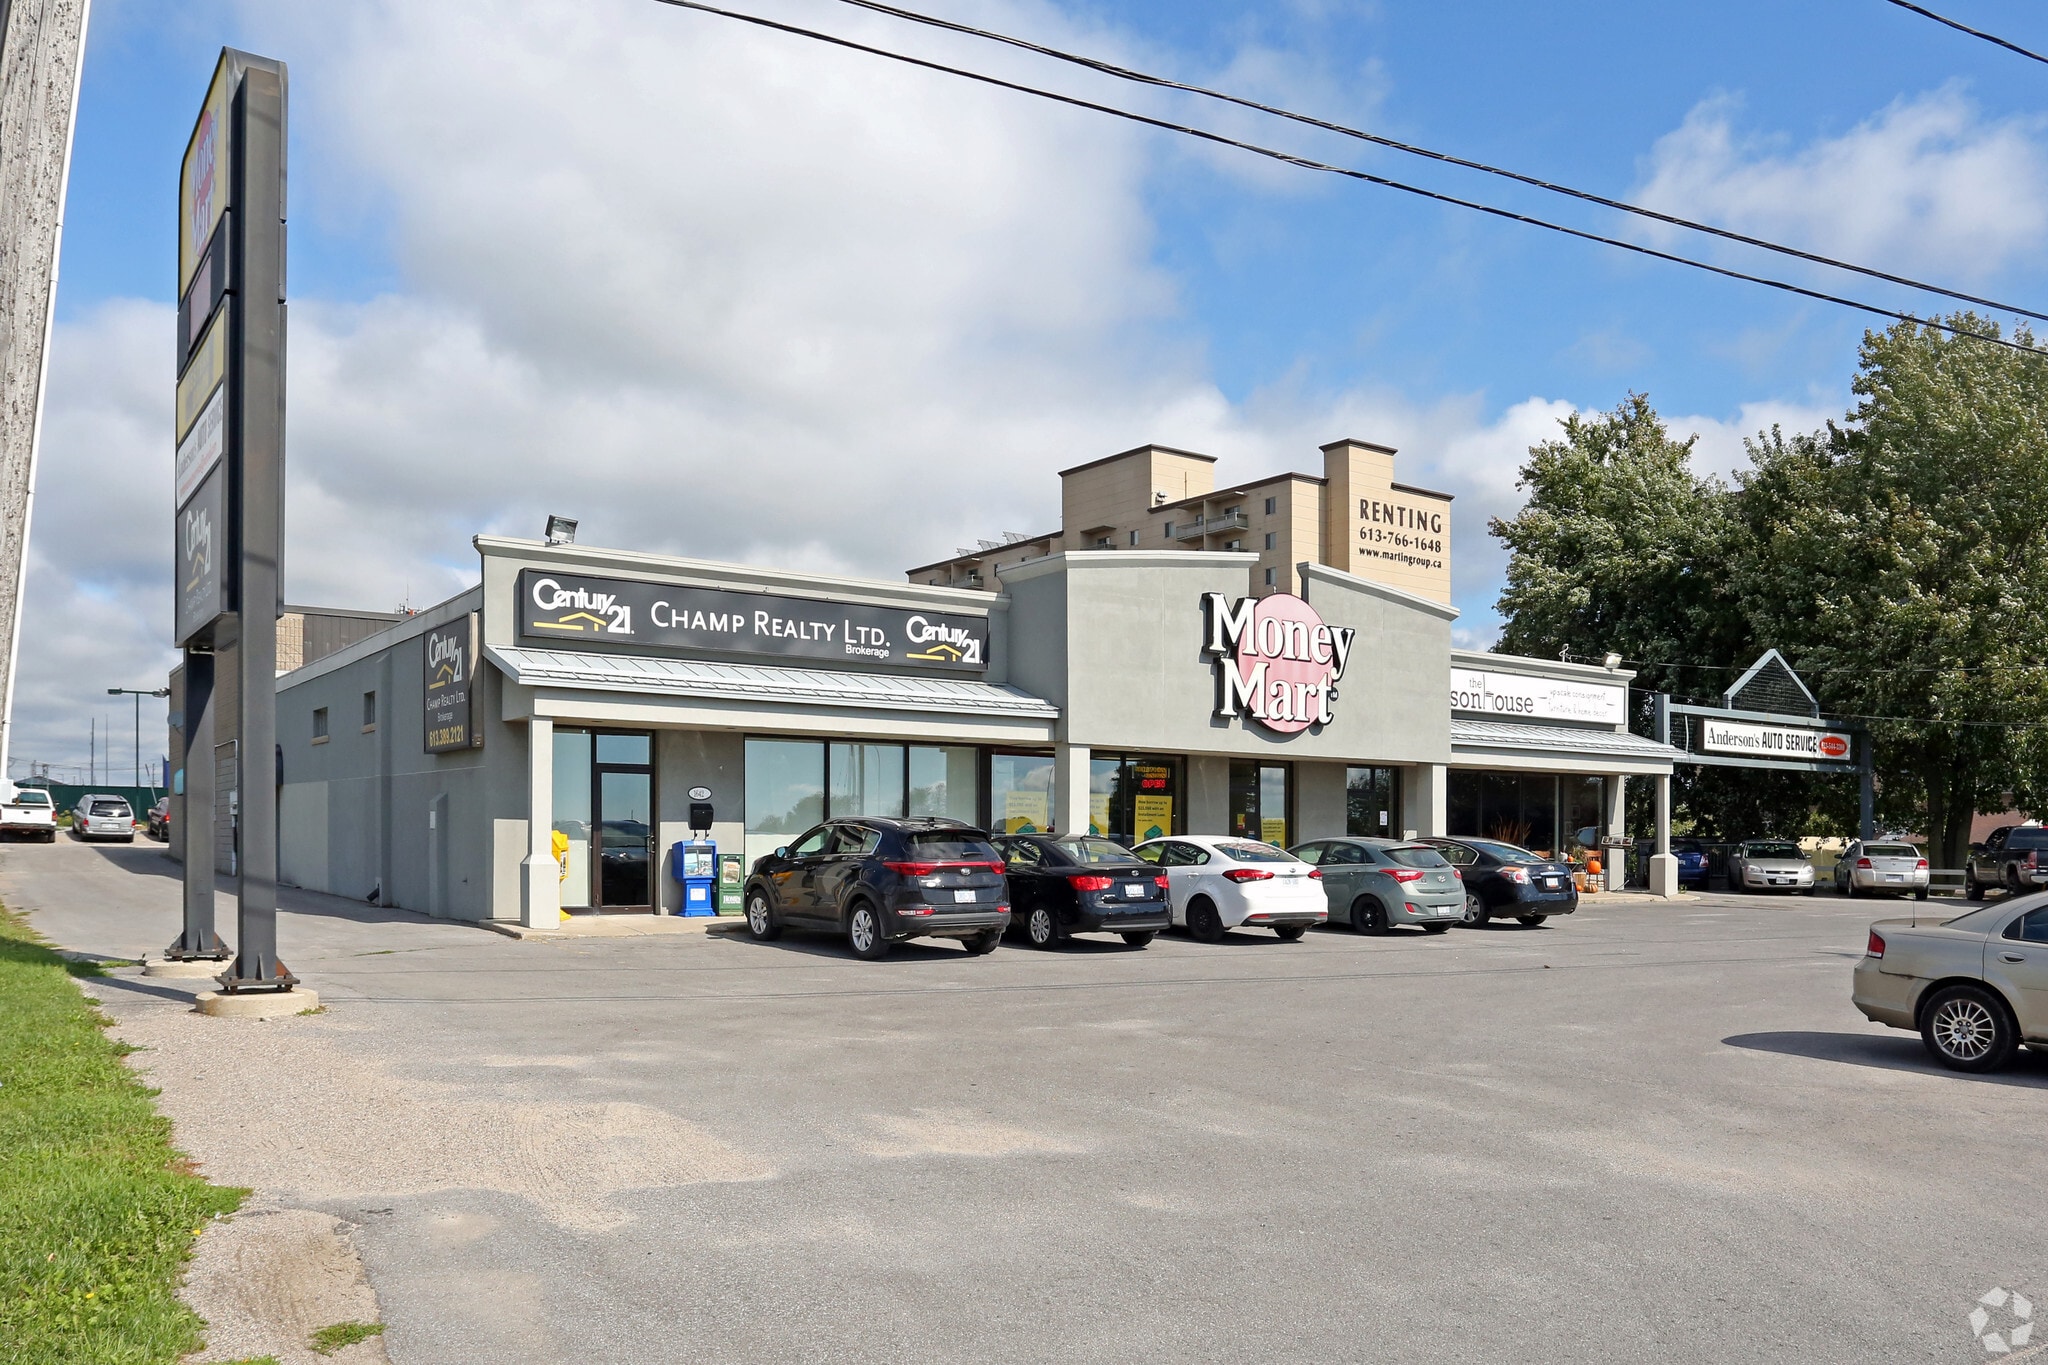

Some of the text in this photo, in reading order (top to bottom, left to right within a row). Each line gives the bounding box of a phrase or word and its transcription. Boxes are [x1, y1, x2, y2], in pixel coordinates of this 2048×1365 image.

[1360, 498, 1442, 534] RENTING
[1360, 526, 1442, 553] 613-766-1648
[1359, 547, 1442, 569] www.martingroup.ca
[532, 578, 616, 614] Century
[607, 605, 635, 634] 21
[651, 600, 891, 647] CHAMP REALTY LTD.
[906, 615, 970, 647] Century
[429, 632, 457, 668] Century
[962, 638, 982, 664] 21
[1204, 592, 1355, 681] Money
[453, 647, 462, 682] 21
[845, 644, 890, 659] Brokerage
[1215, 657, 1334, 725] Mart
[1469, 678, 1482, 689] the
[427, 697, 441, 711] CHAMP
[441, 693, 456, 709] REALTY
[1707, 726, 1817, 753] Anderson's AUTO SERVICE
[1142, 779, 1166, 788] OPEN
